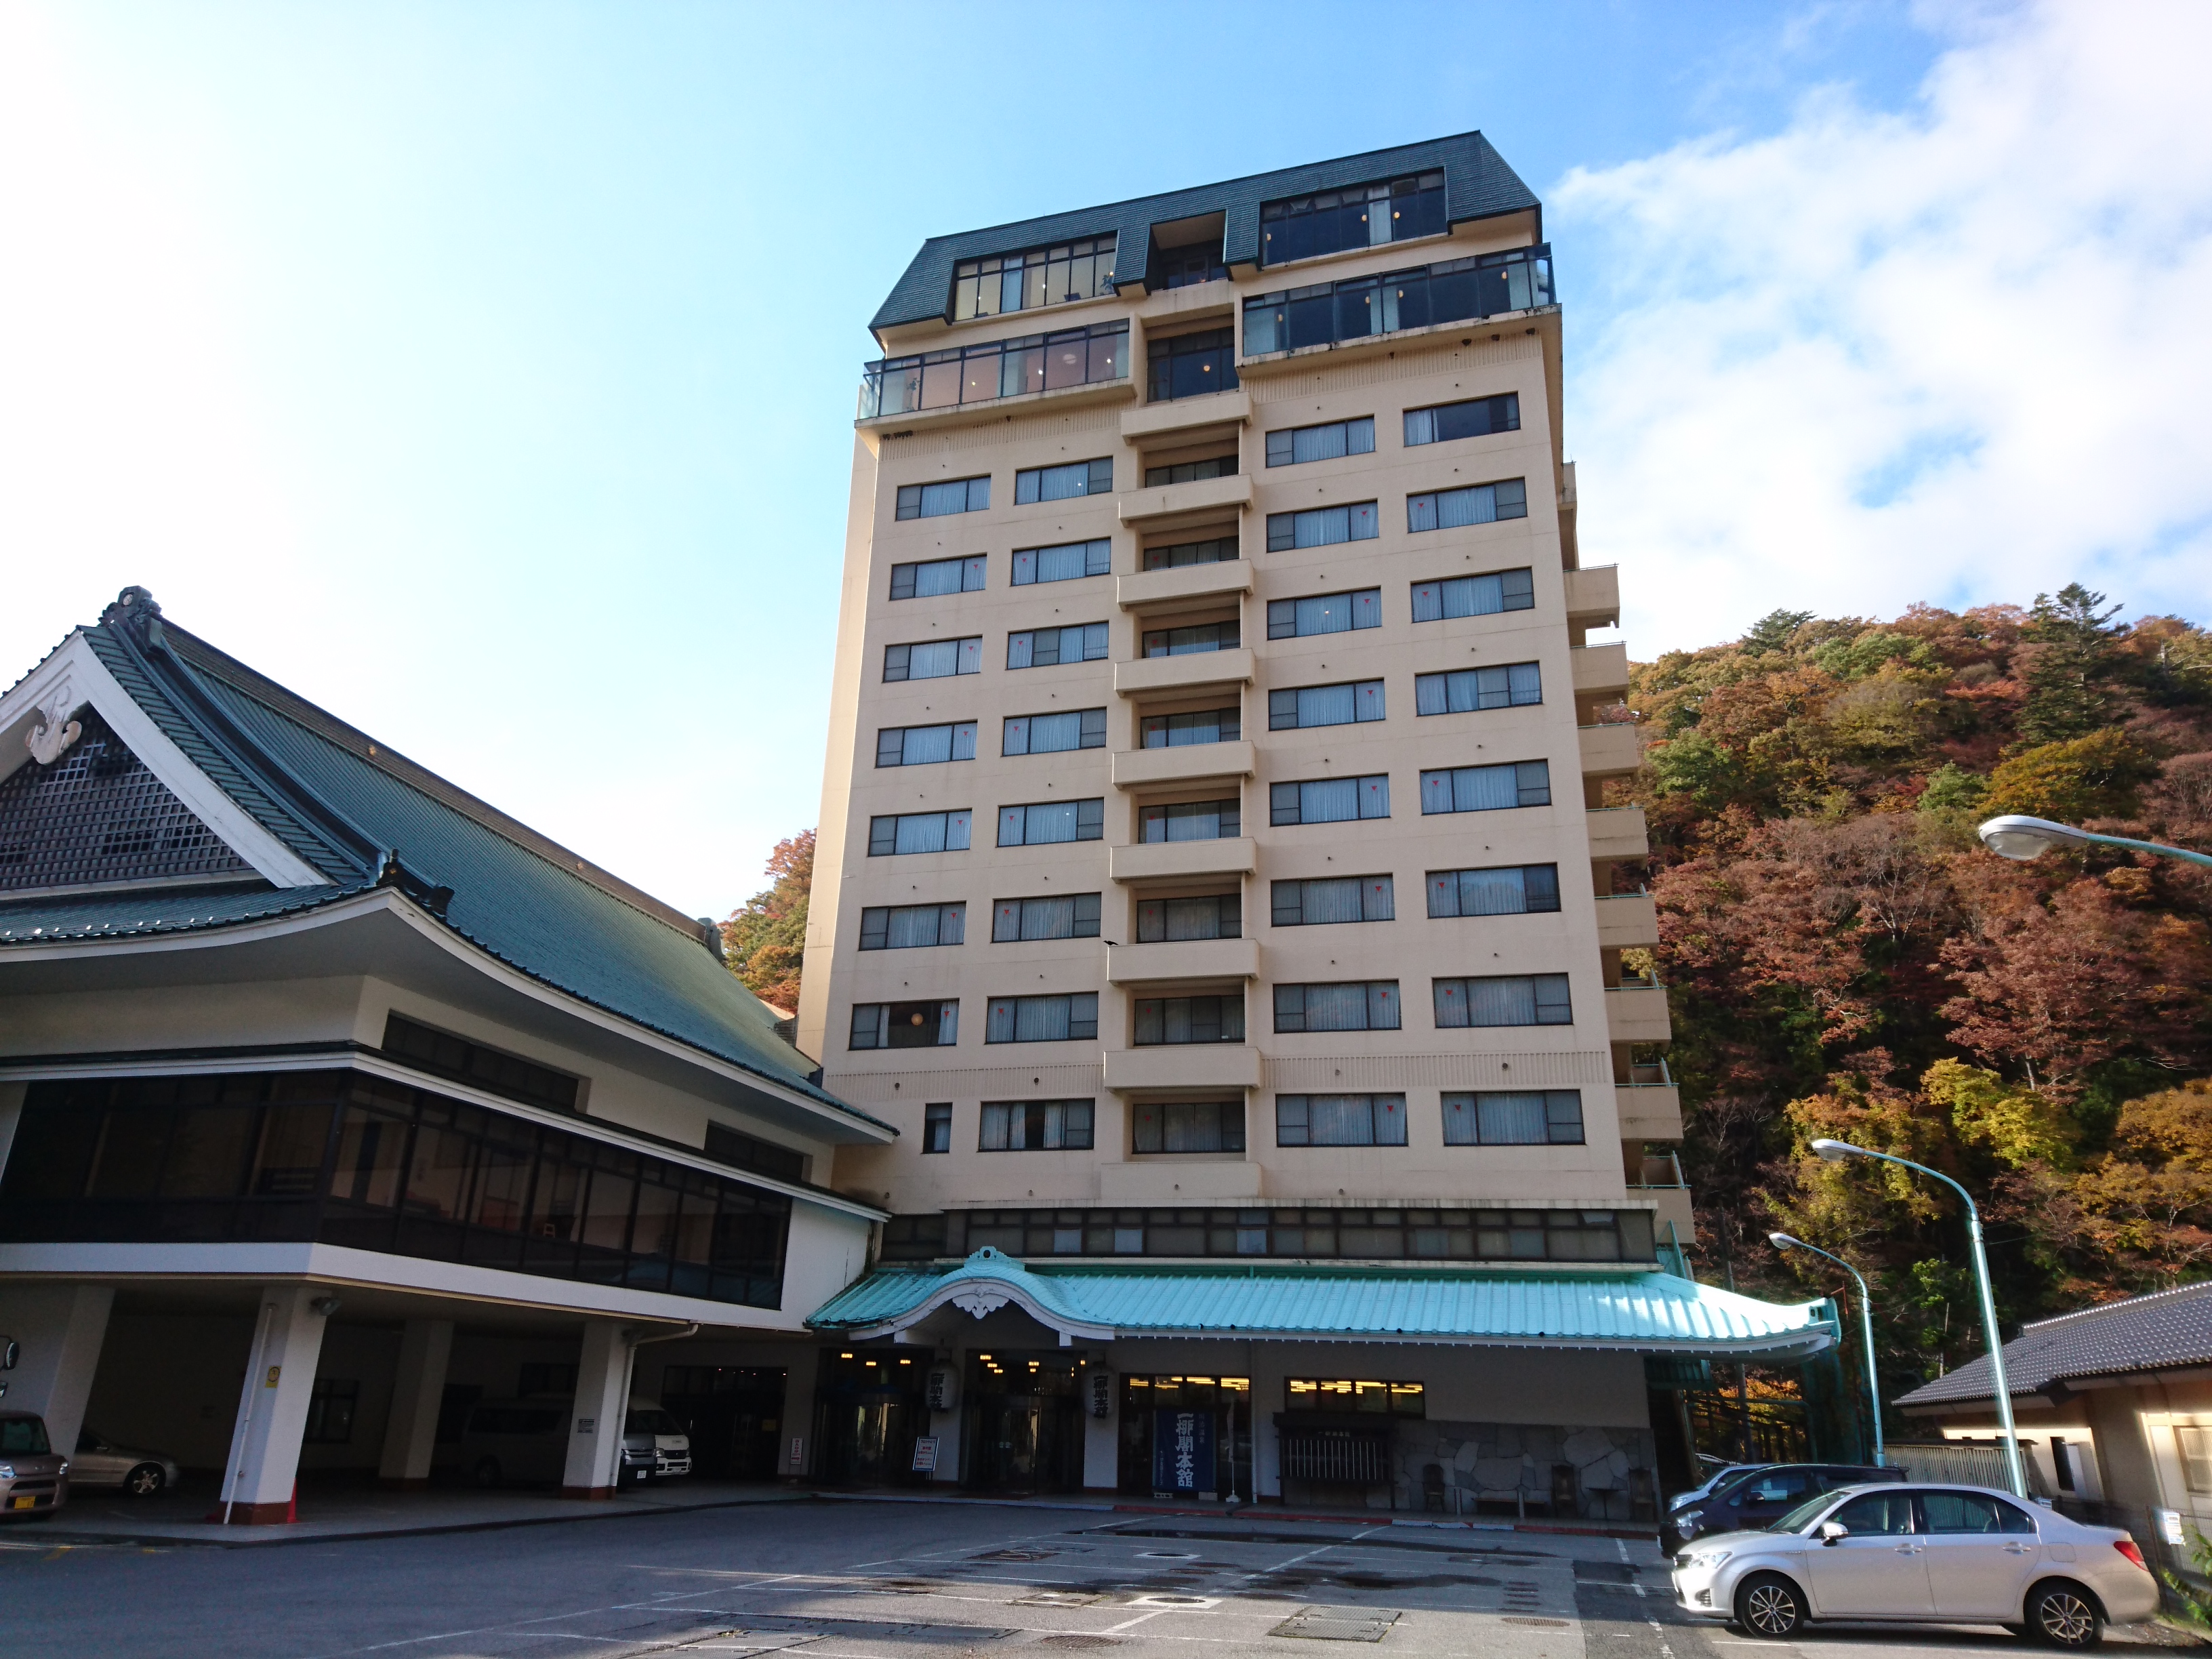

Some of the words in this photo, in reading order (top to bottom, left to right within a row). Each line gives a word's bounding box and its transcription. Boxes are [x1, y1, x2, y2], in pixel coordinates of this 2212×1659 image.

[1174, 1412, 1195, 1488] 一柳閣本館
